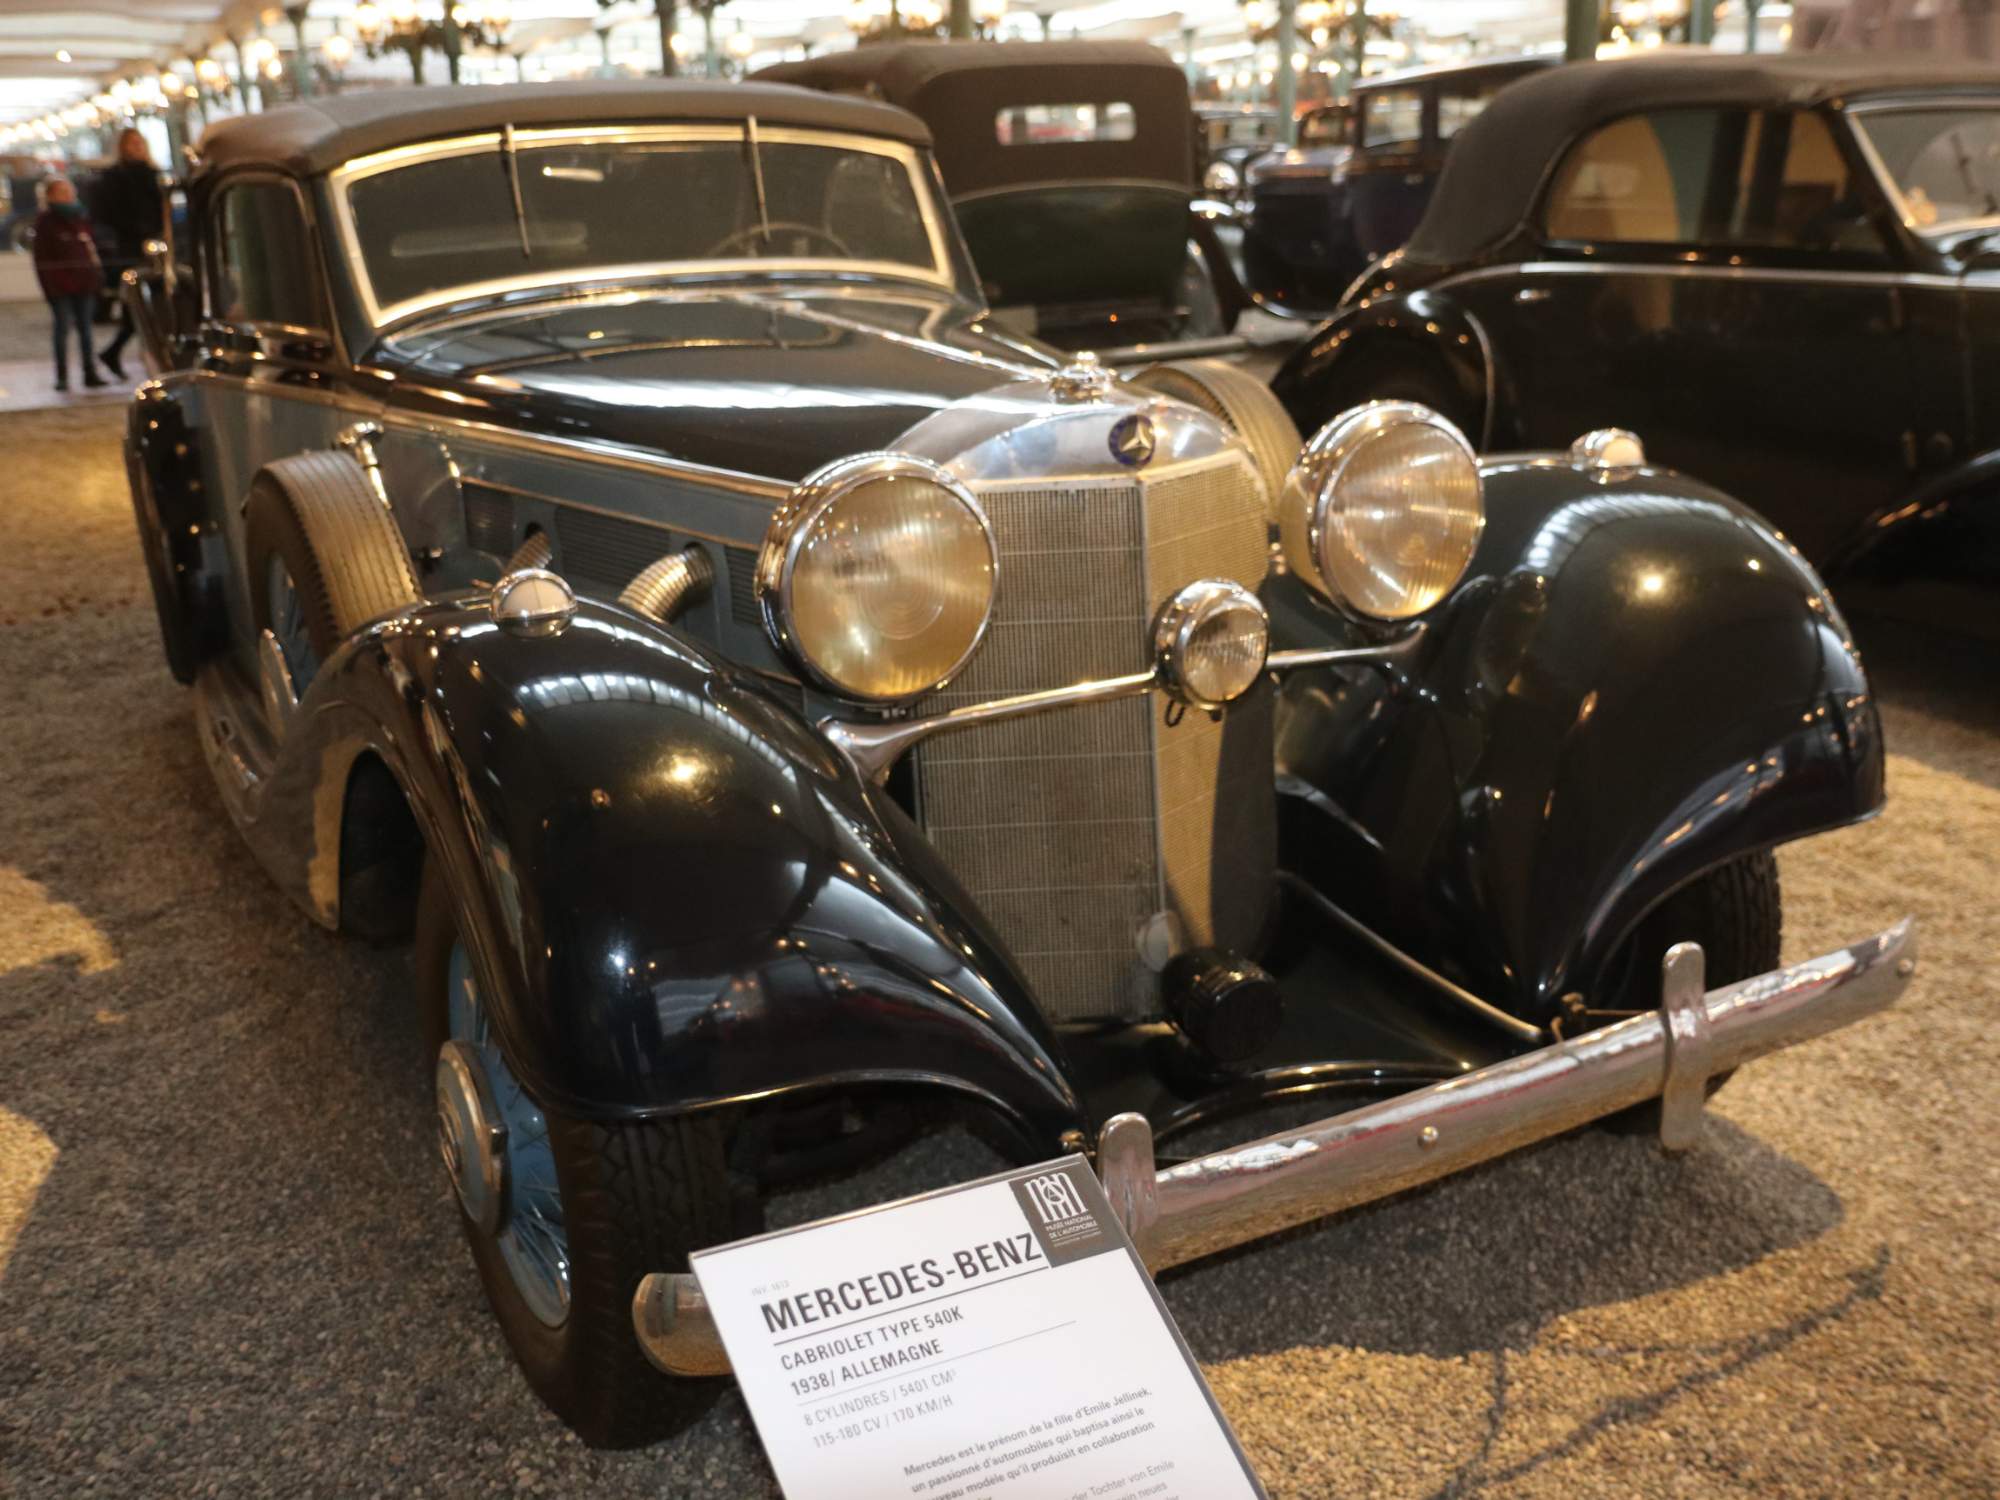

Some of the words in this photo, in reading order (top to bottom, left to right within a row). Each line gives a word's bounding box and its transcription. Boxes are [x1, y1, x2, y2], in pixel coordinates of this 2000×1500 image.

[760, 1232, 1043, 1333] MERCEDES-BENZ
[780, 1331, 875, 1371] CABRIOLET
[878, 1317, 923, 1342] TYPE
[924, 1306, 964, 1330] 540K
[841, 1338, 944, 1382] ALLEMAGNE
[804, 1413, 813, 1426] 8
[815, 1389, 890, 1423] CYLINDRES
[899, 1378, 929, 1397] 5401
[813, 1423, 862, 1448] 115-180
[863, 1416, 881, 1433] CV
[892, 1406, 914, 1423] 170
[916, 1393, 954, 1416] KM/H
[904, 1454, 956, 1477] Mercedes
[958, 1446, 975, 1459] est
[976, 1442, 986, 1453] le
[1029, 1423, 1042, 1435] de
[1043, 1420, 1054, 1431] la
[1054, 1413, 1074, 1426] fille
[1075, 1399, 1111, 1420] d'Emile
[911, 1481, 926, 1493] un
[927, 1462, 981, 1489] passionné
[983, 1438, 1054, 1469] d'automobiles
[1055, 1431, 1073, 1446] qui
[1072, 1419, 1110, 1439] baptisa
[1111, 1411, 1134, 1425] ainsi
[1134, 1407, 1145, 1417] le
[966, 1472, 1005, 1493] modèle
[1006, 1463, 1030, 1480] qu'il
[1031, 1447, 1077, 1472] produisit
[1078, 1443, 1091, 1455] en
[1092, 1421, 1156, 1449] collaboration
[1090, 1477, 1127, 1497] Tochter
[1127, 1471, 1147, 1483] von
[1146, 1460, 1176, 1477] Emile
[1137, 1481, 1168, 1497] neues
